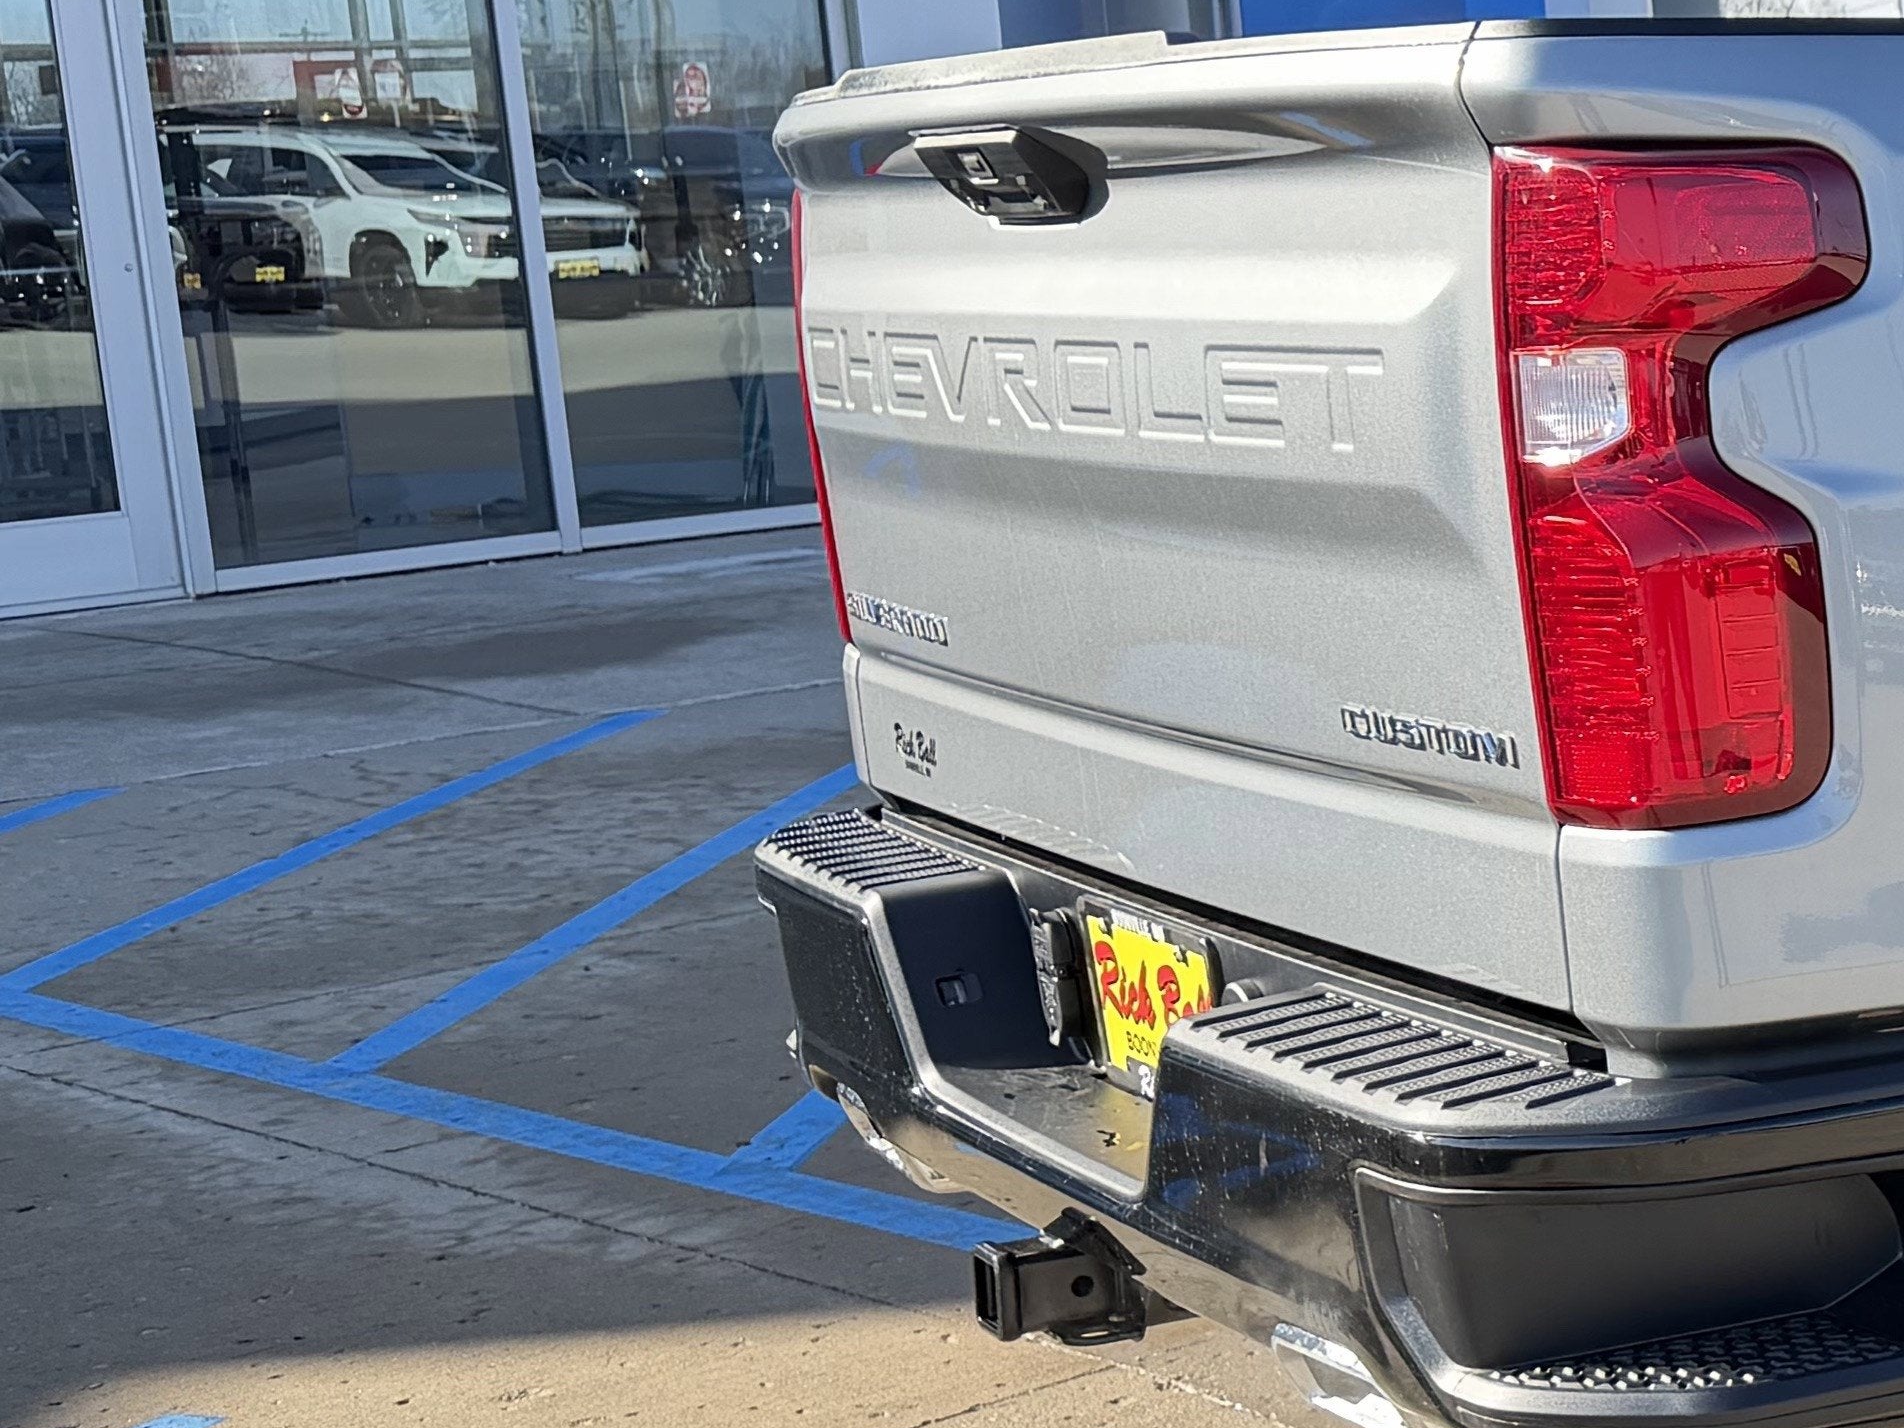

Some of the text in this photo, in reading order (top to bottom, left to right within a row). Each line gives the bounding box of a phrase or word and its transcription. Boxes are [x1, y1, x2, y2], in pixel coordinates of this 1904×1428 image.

[805, 327, 1385, 453] CHEVROLET
[1341, 703, 1521, 770] CUSTOM
[1095, 940, 1157, 1031] Rick
